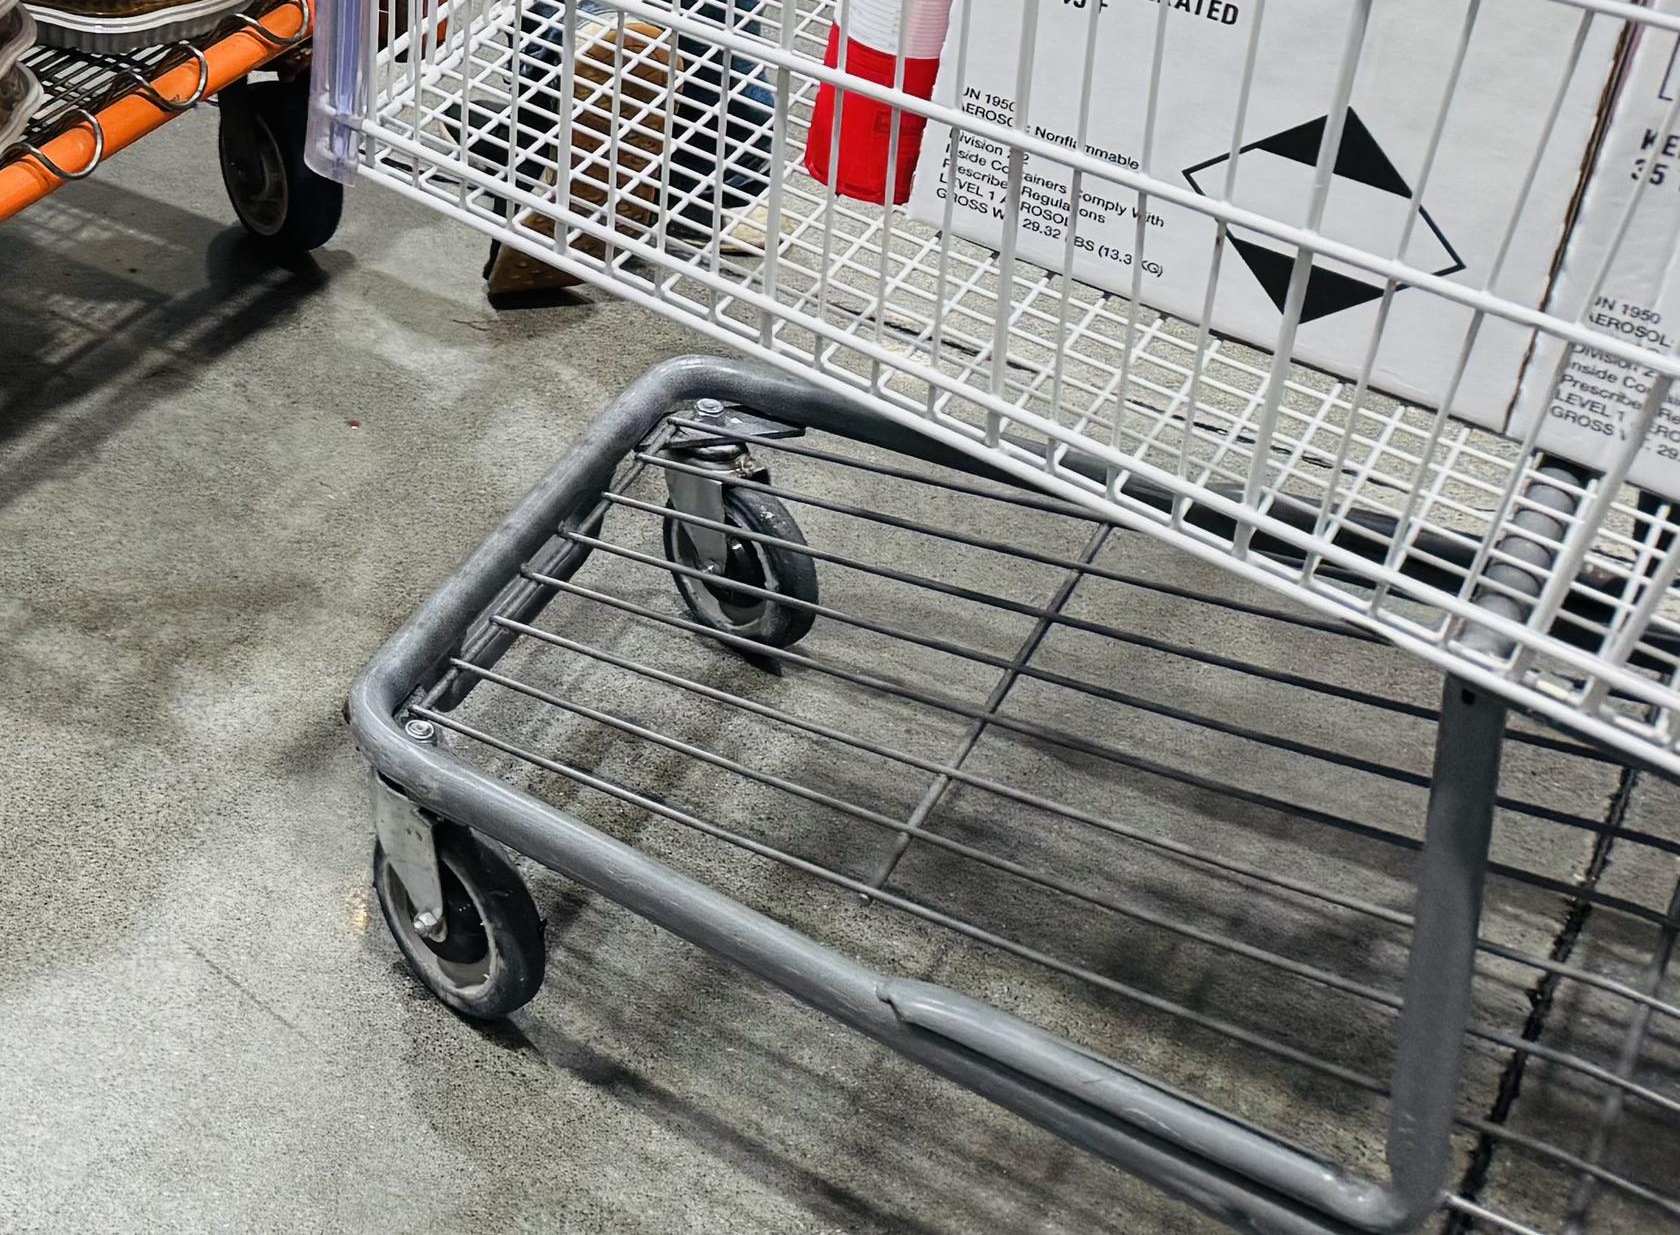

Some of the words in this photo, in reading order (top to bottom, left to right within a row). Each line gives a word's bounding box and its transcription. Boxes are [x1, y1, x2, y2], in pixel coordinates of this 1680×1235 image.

[1022, 218, 1061, 240] 29.32
[1621, 303, 1661, 324] 1950
[1555, 389, 1611, 418] LEVEL
[1551, 405, 1615, 436] GROSS
